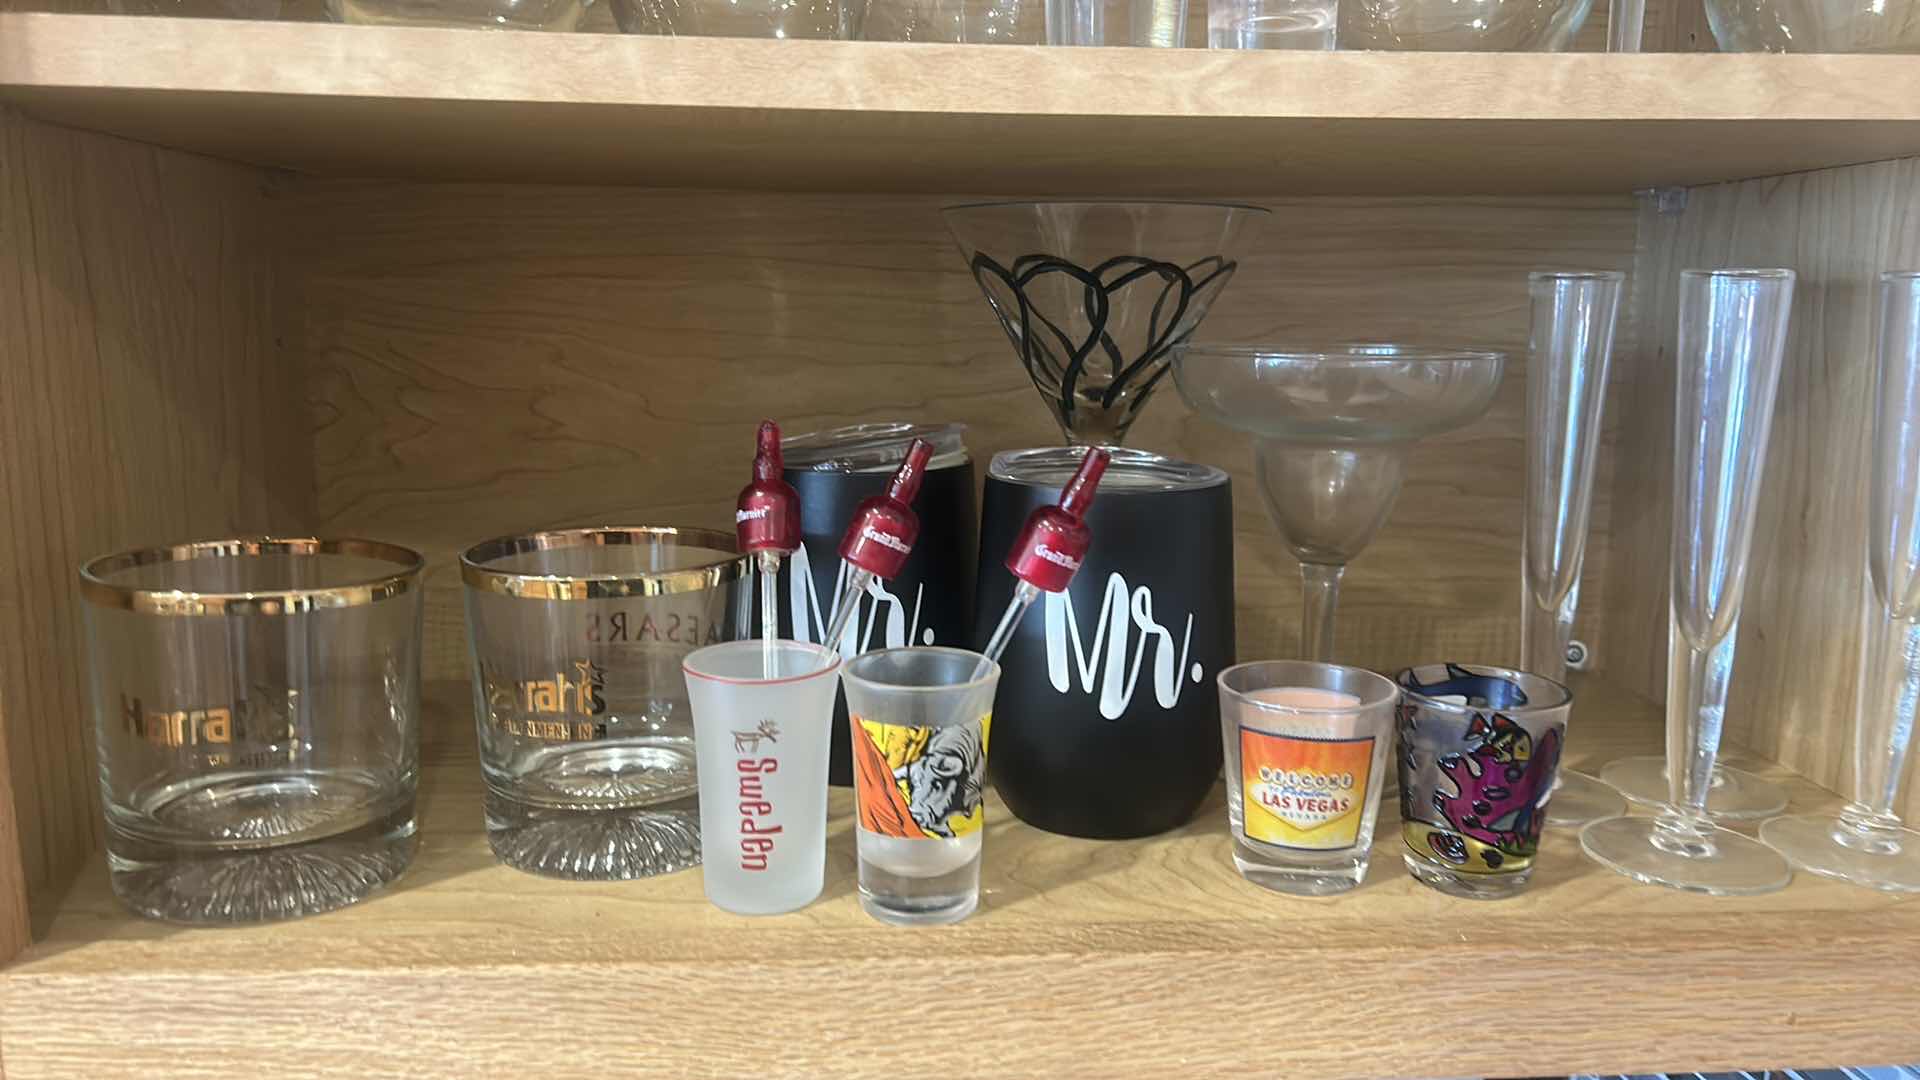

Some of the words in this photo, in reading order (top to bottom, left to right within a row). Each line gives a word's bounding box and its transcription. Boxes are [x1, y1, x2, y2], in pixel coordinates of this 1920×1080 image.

[1045, 571, 1203, 721] Mr.
[1259, 767, 1353, 789] WELCOME
[1262, 791, 1290, 808] LAS
[1296, 797, 1350, 812] VEGAS
[737, 758, 784, 872] Sweden
